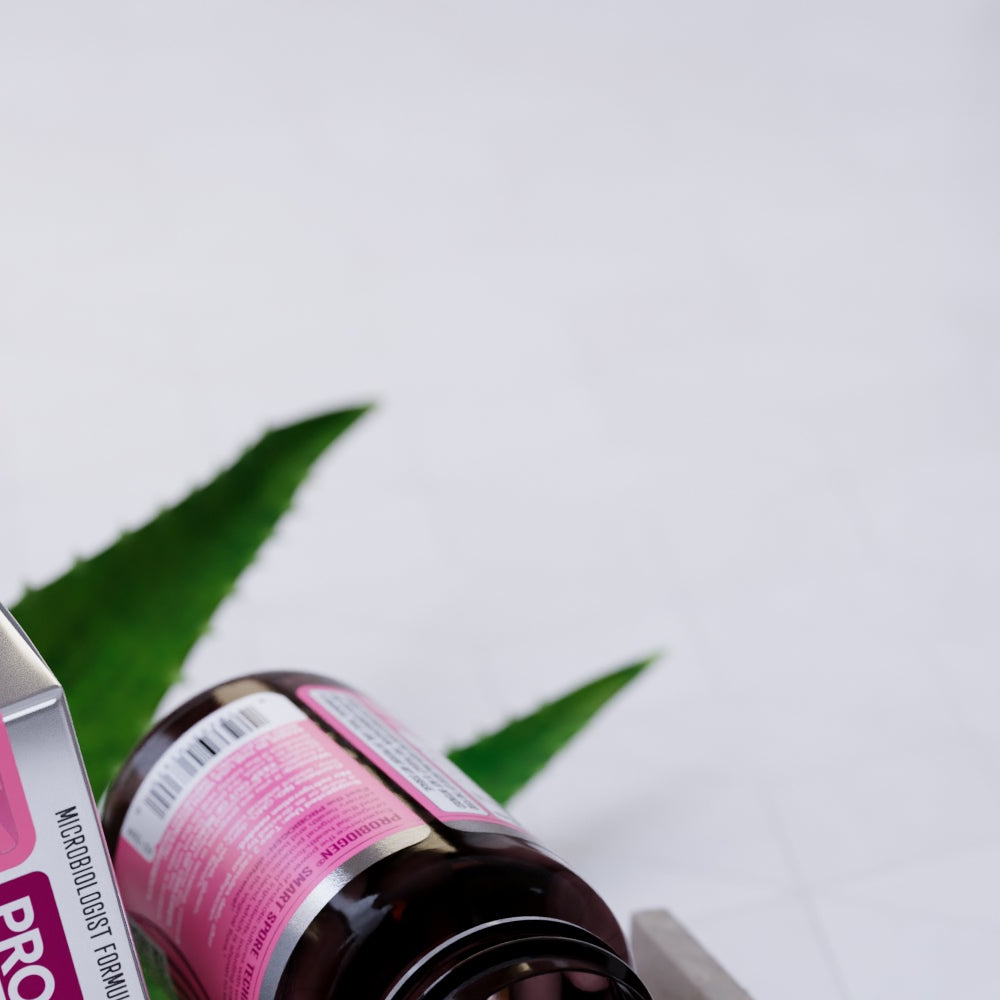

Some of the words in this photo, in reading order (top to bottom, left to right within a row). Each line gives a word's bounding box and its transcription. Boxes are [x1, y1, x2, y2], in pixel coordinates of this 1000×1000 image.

[55, 806, 112, 939] MICROBIOLOGIST
[276, 867, 314, 911] SMART
[250, 914, 278, 958] SPORE
